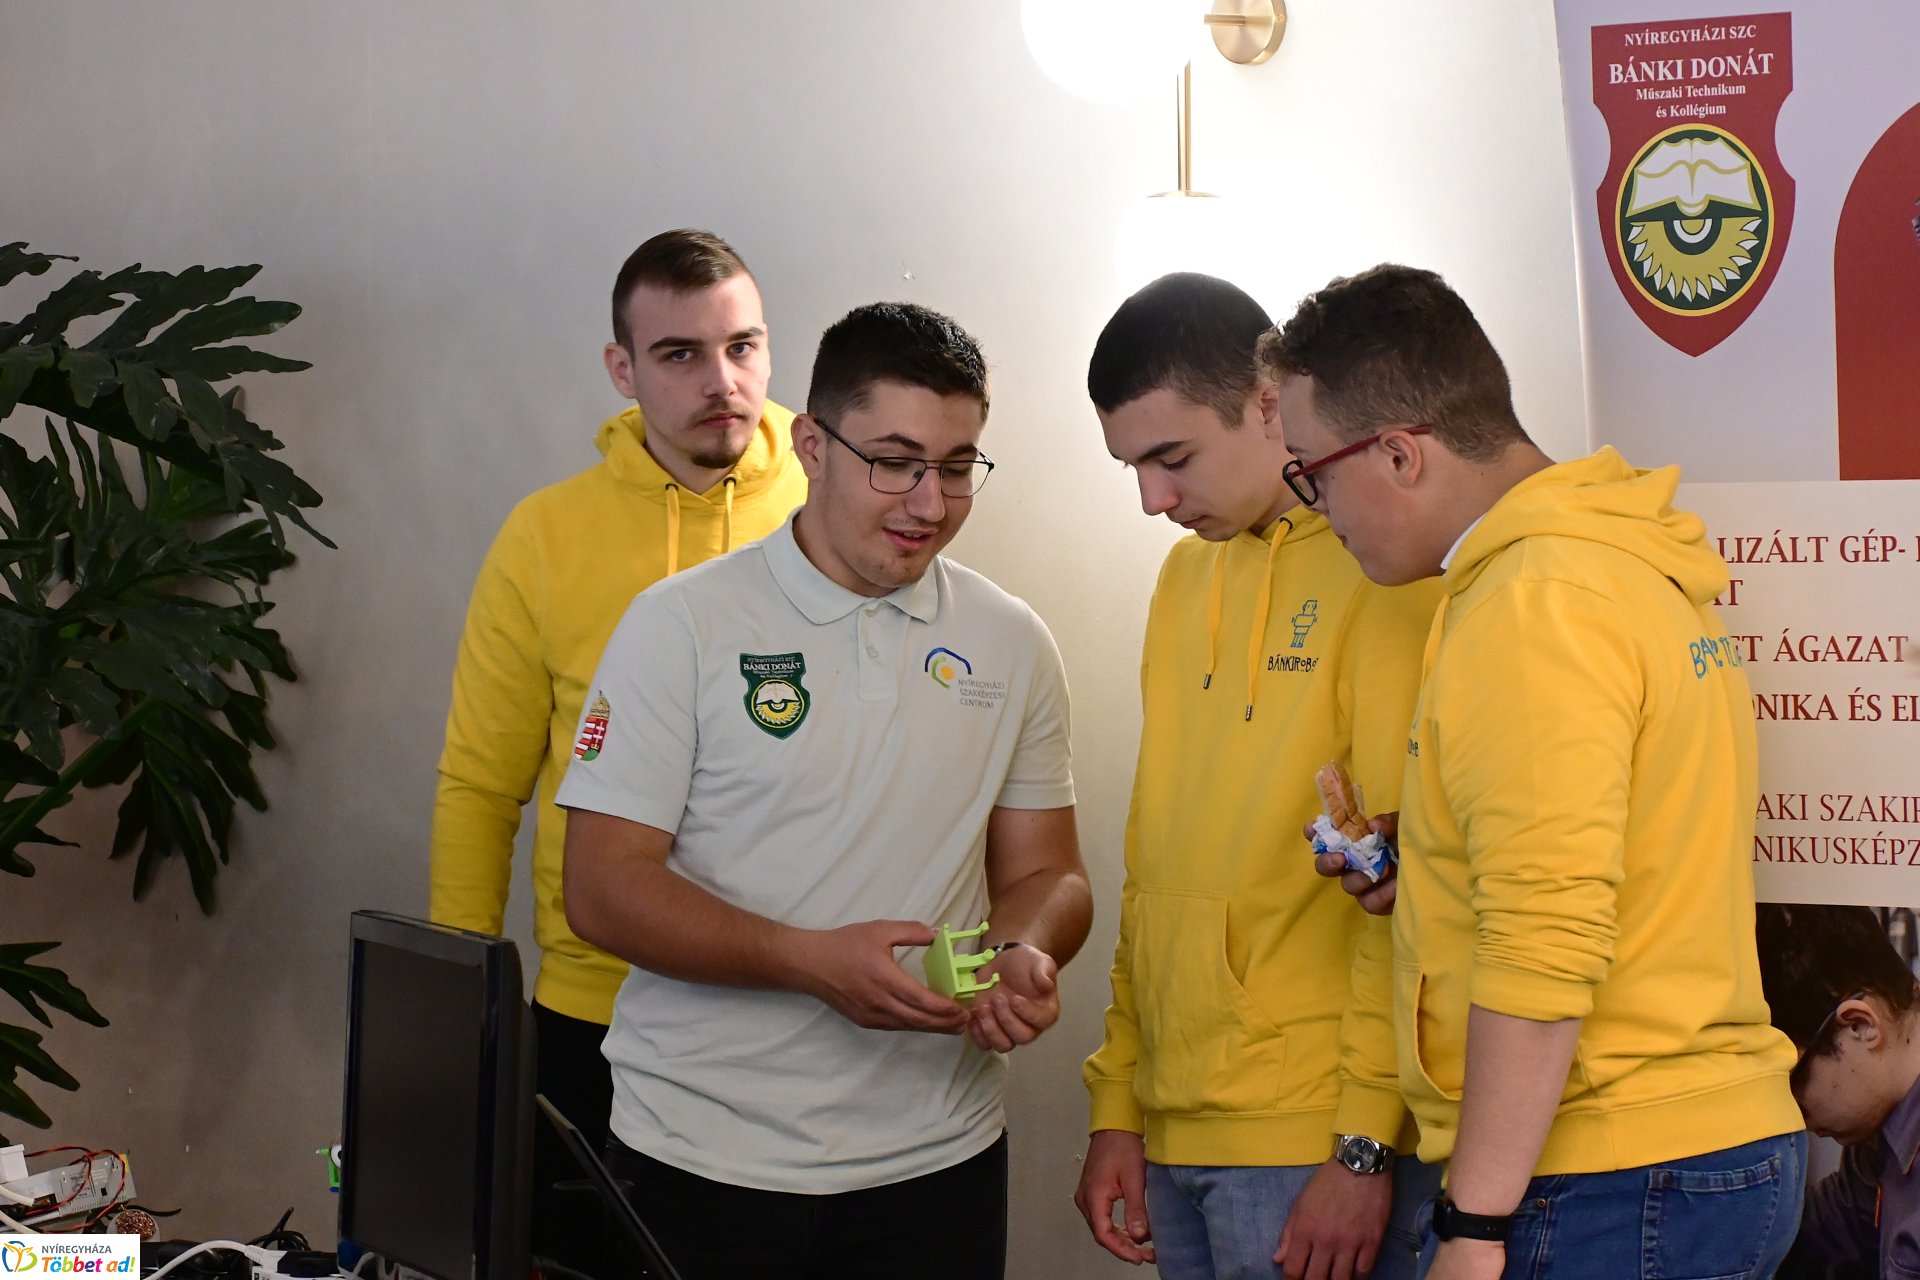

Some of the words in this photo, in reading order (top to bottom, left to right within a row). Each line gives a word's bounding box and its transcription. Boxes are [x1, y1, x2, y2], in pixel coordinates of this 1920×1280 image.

[1624, 25, 1726, 46] NYÍREGYHÁZI
[1729, 24, 1757, 39] SZC
[1608, 56, 1684, 85] BÁNKI
[1690, 48, 1774, 79] DONÁT
[1636, 85, 1683, 101] Műszaki
[1685, 83, 1746, 98] Technikum
[1655, 105, 1667, 118] és
[1670, 103, 1727, 119] Kollégium
[1717, 529, 1829, 563] LIZÁLT
[1839, 528, 1906, 562] GÉP-
[1713, 579, 1744, 606] T
[1773, 628, 1909, 663] ÁGAZAT
[743, 661, 770, 671] BÁNKI
[771, 660, 802, 671] DONÁT
[1752, 694, 1839, 721] NIKA
[1848, 687, 1882, 722] ÉS
[1756, 793, 1809, 821] AKI
